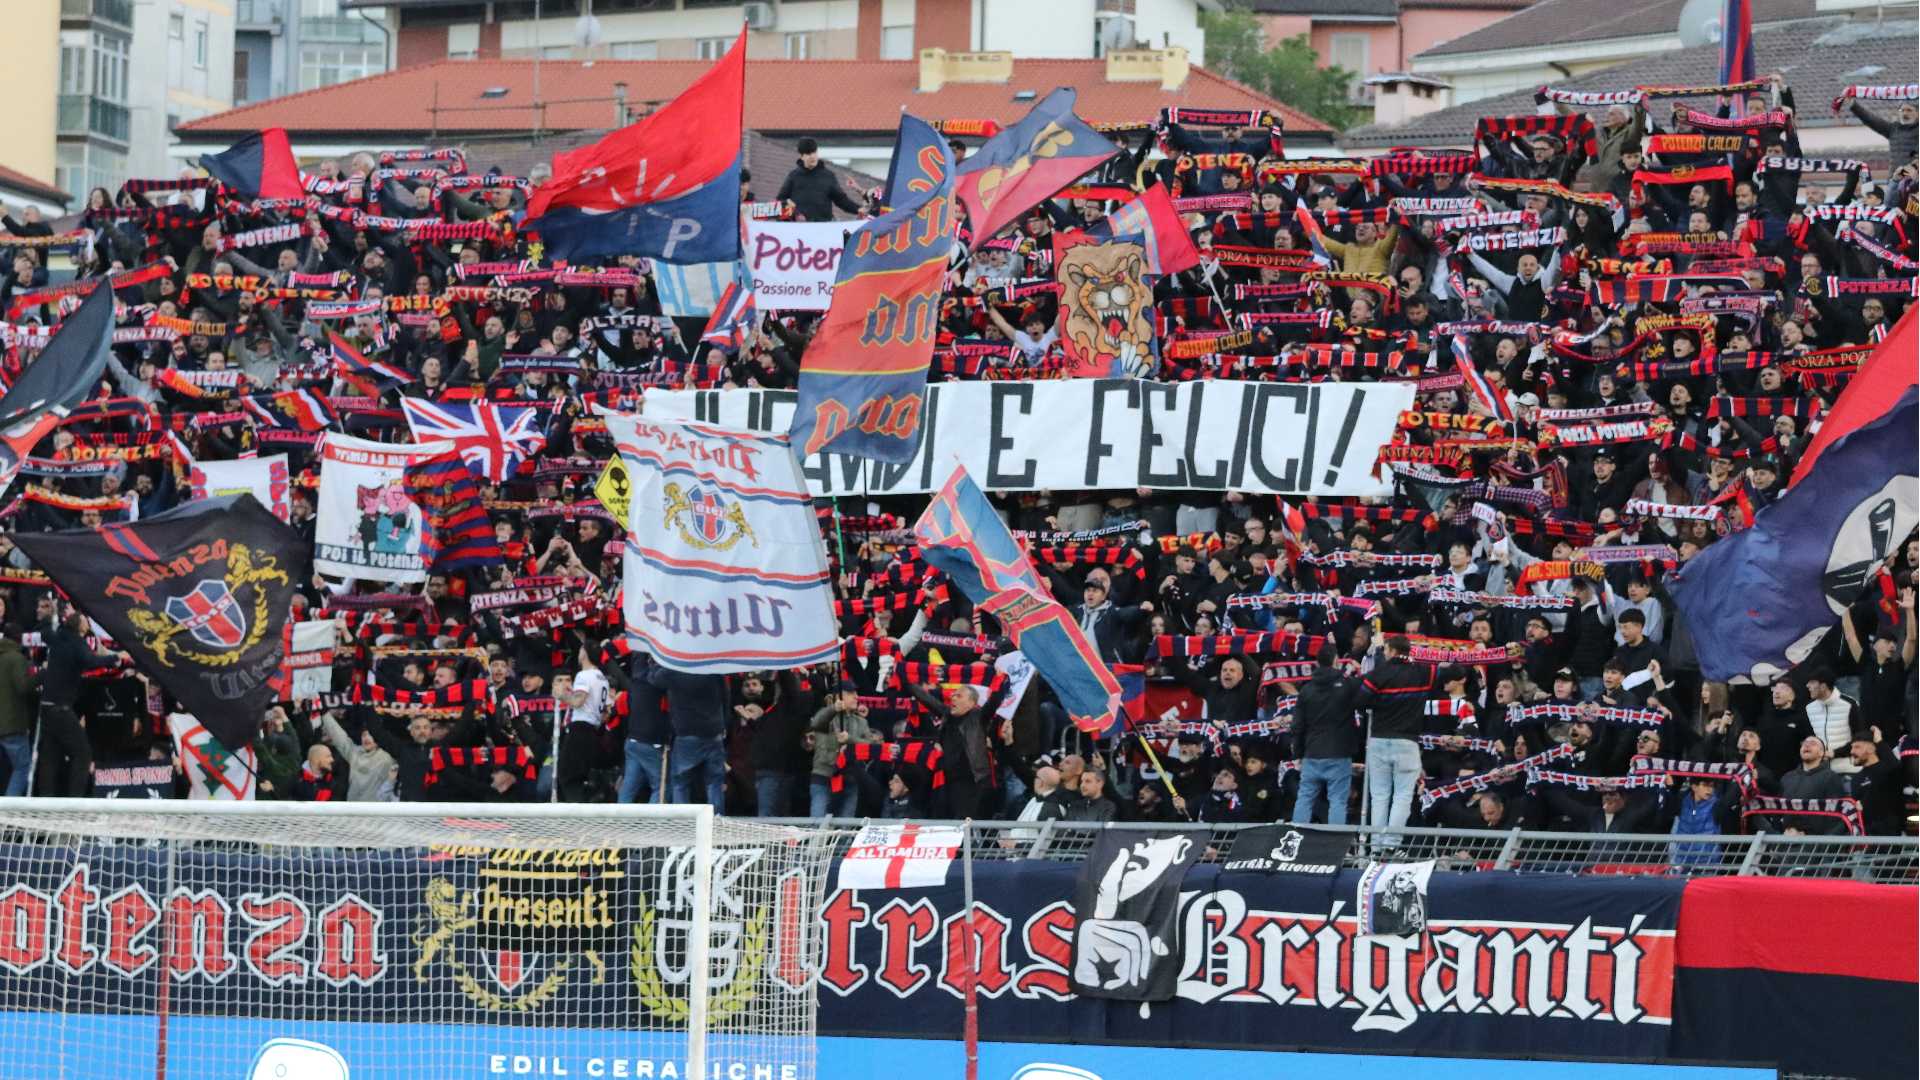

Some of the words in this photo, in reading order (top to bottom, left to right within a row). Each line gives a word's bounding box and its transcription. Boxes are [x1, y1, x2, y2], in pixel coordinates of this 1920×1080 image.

[1661, 136, 1705, 151] POTENZA
[1707, 136, 1742, 151] CALCIO
[1767, 157, 1857, 172] ULTRAS
[1442, 210, 1522, 229] POTENZA
[1808, 204, 1896, 226] POTENZA
[234, 223, 301, 249] POTENZA
[753, 278, 812, 296] Passione
[1838, 279, 1911, 293] POTENZA
[1219, 330, 1254, 352] CALCIO
[1791, 353, 1835, 369] FORZA
[1538, 406, 1607, 420] POTENZA
[985, 382, 1037, 488] E
[1084, 378, 1367, 492] FELICI!
[1449, 646, 1506, 662] POTENZA
[849, 846, 950, 861] ALTAMURA
[1276, 861, 1337, 874] RIONERO
[480, 881, 615, 929] Presenti
[0, 860, 388, 988] otenza
[769, 866, 1078, 1001] ltras
[491, 1054, 569, 1078] EDIL
[587, 1055, 798, 1080] CERAICHE
